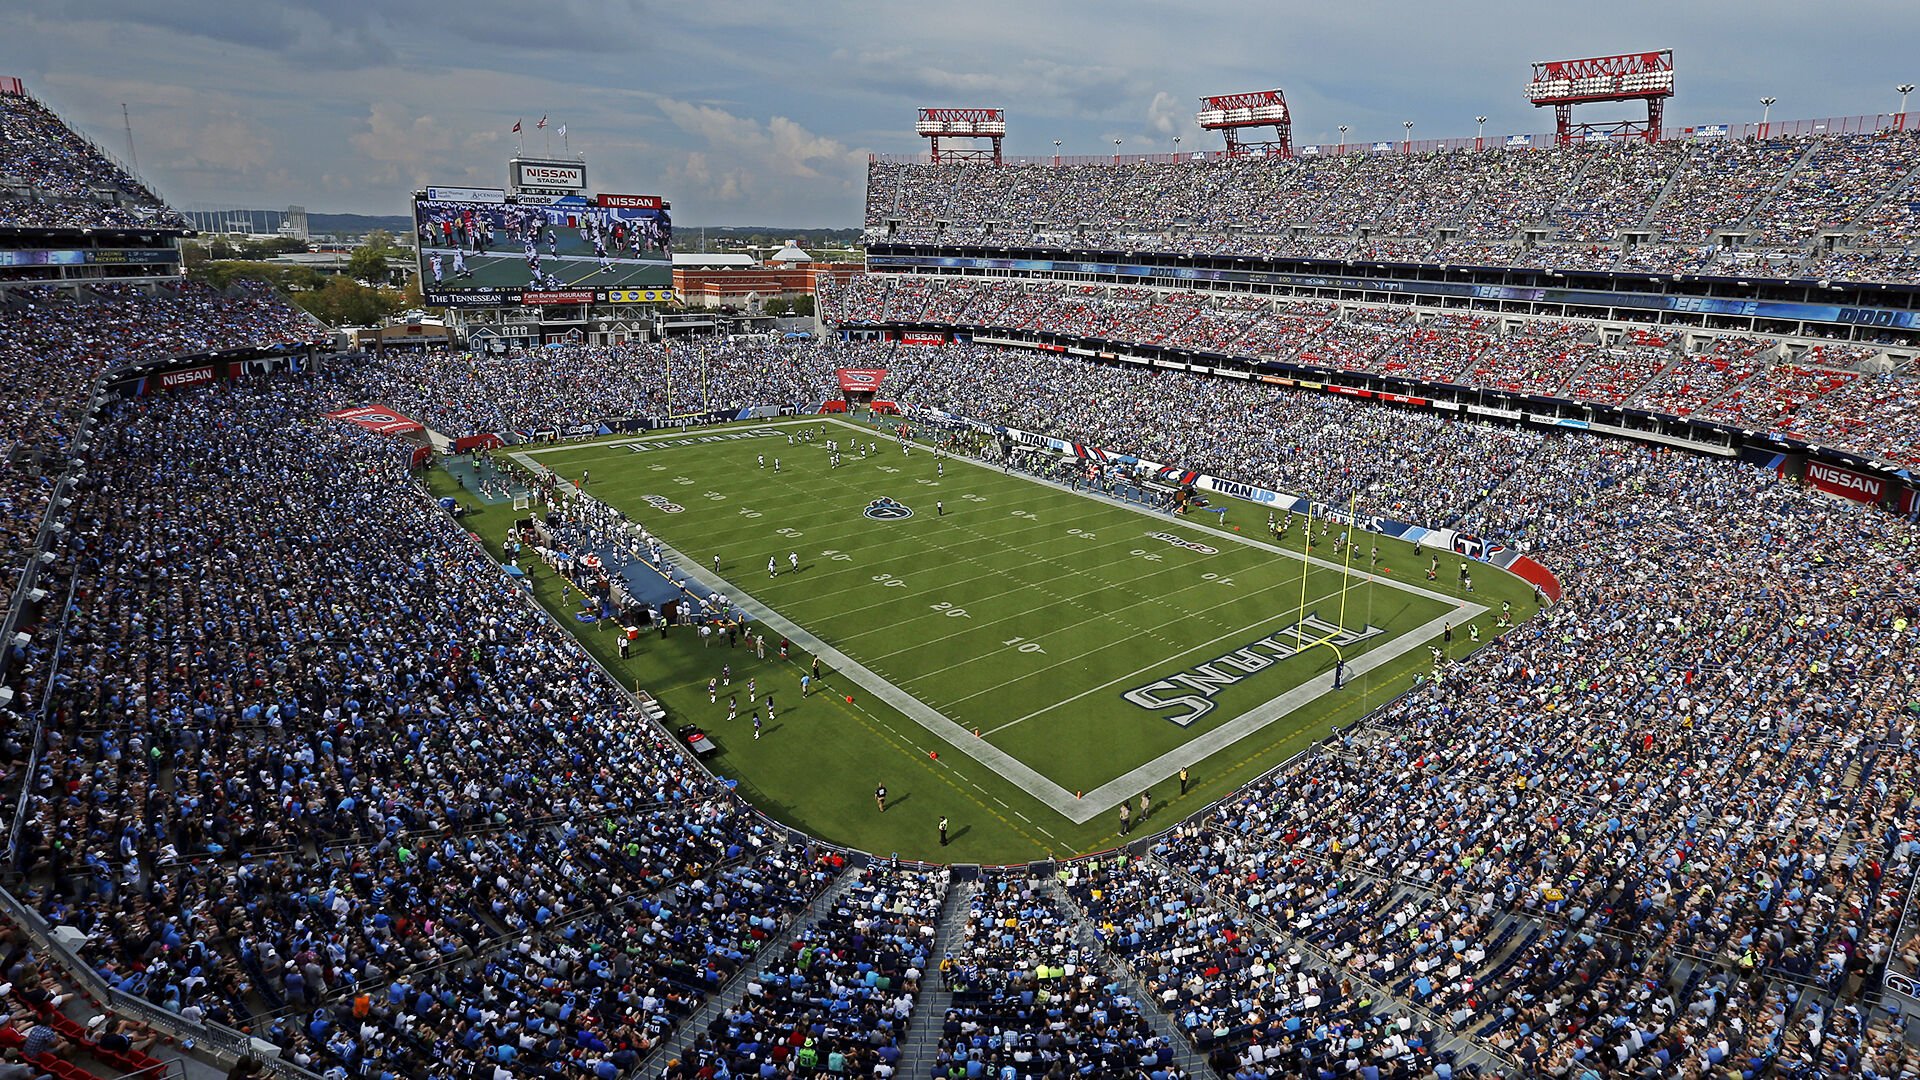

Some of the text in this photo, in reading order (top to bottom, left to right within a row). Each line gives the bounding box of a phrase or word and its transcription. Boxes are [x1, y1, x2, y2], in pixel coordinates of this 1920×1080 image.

[527, 169, 577, 178] NISSAN
[518, 194, 551, 204] Pinnacle
[607, 198, 653, 206] NISSAN
[163, 369, 212, 385] NISSAN
[1810, 465, 1879, 495] NISSAN
[776, 528, 803, 537] 50
[1067, 528, 1095, 539] 30
[821, 550, 850, 561] 40
[1130, 550, 1162, 561] 20
[872, 574, 904, 587] 30
[1201, 573, 1232, 585] 10
[929, 602, 966, 618] 20
[1002, 637, 1041, 654] 10
[1122, 611, 1386, 728] TITANS
